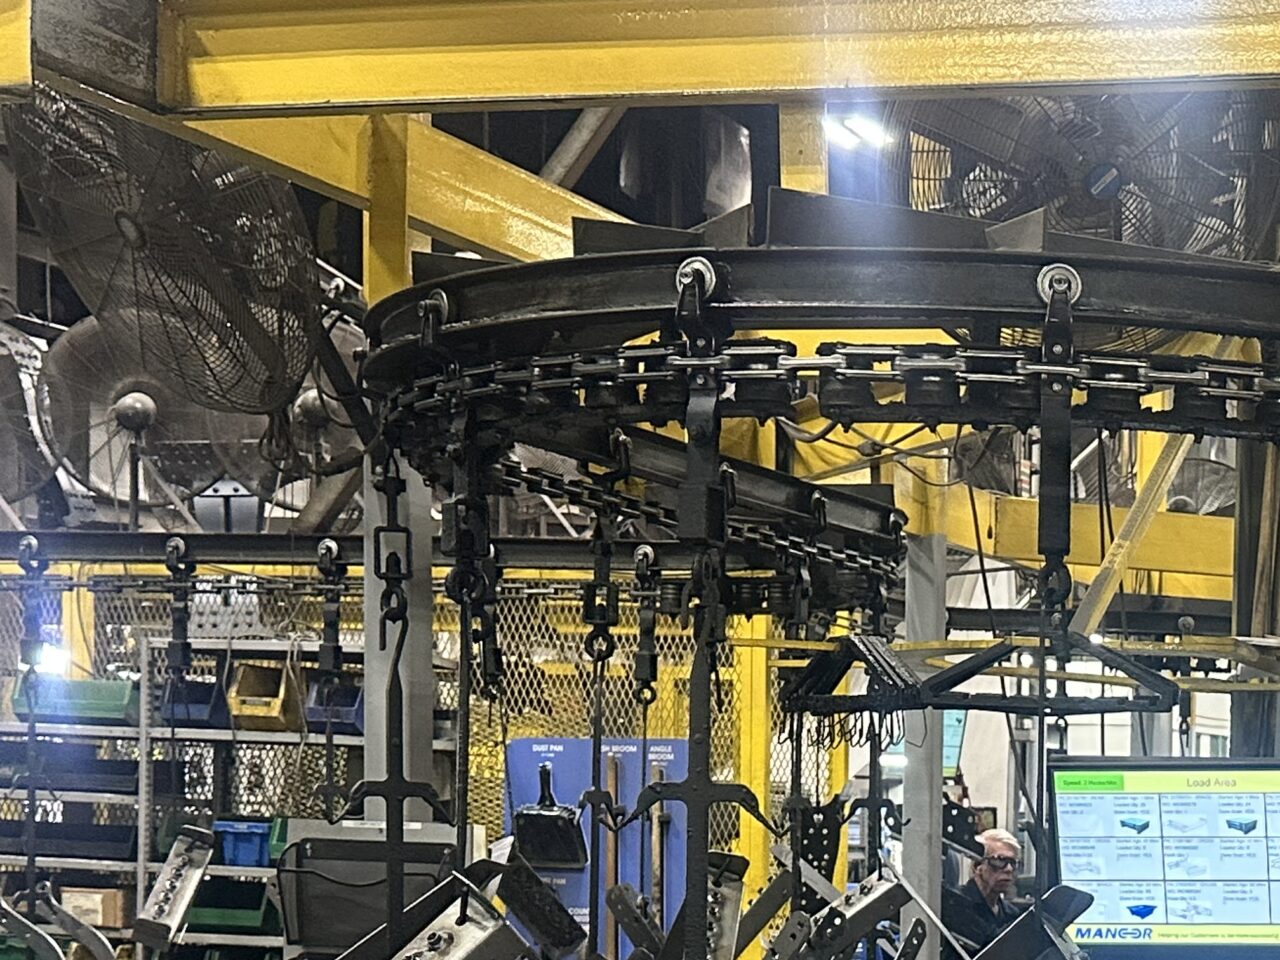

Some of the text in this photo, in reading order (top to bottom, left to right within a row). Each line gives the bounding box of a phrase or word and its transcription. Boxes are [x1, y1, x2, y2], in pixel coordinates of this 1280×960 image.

[532, 744, 564, 752] DUST PAN
[611, 744, 637, 752] BROOM
[649, 745, 673, 753] ANGLE
[1186, 778, 1237, 787] Load Area
